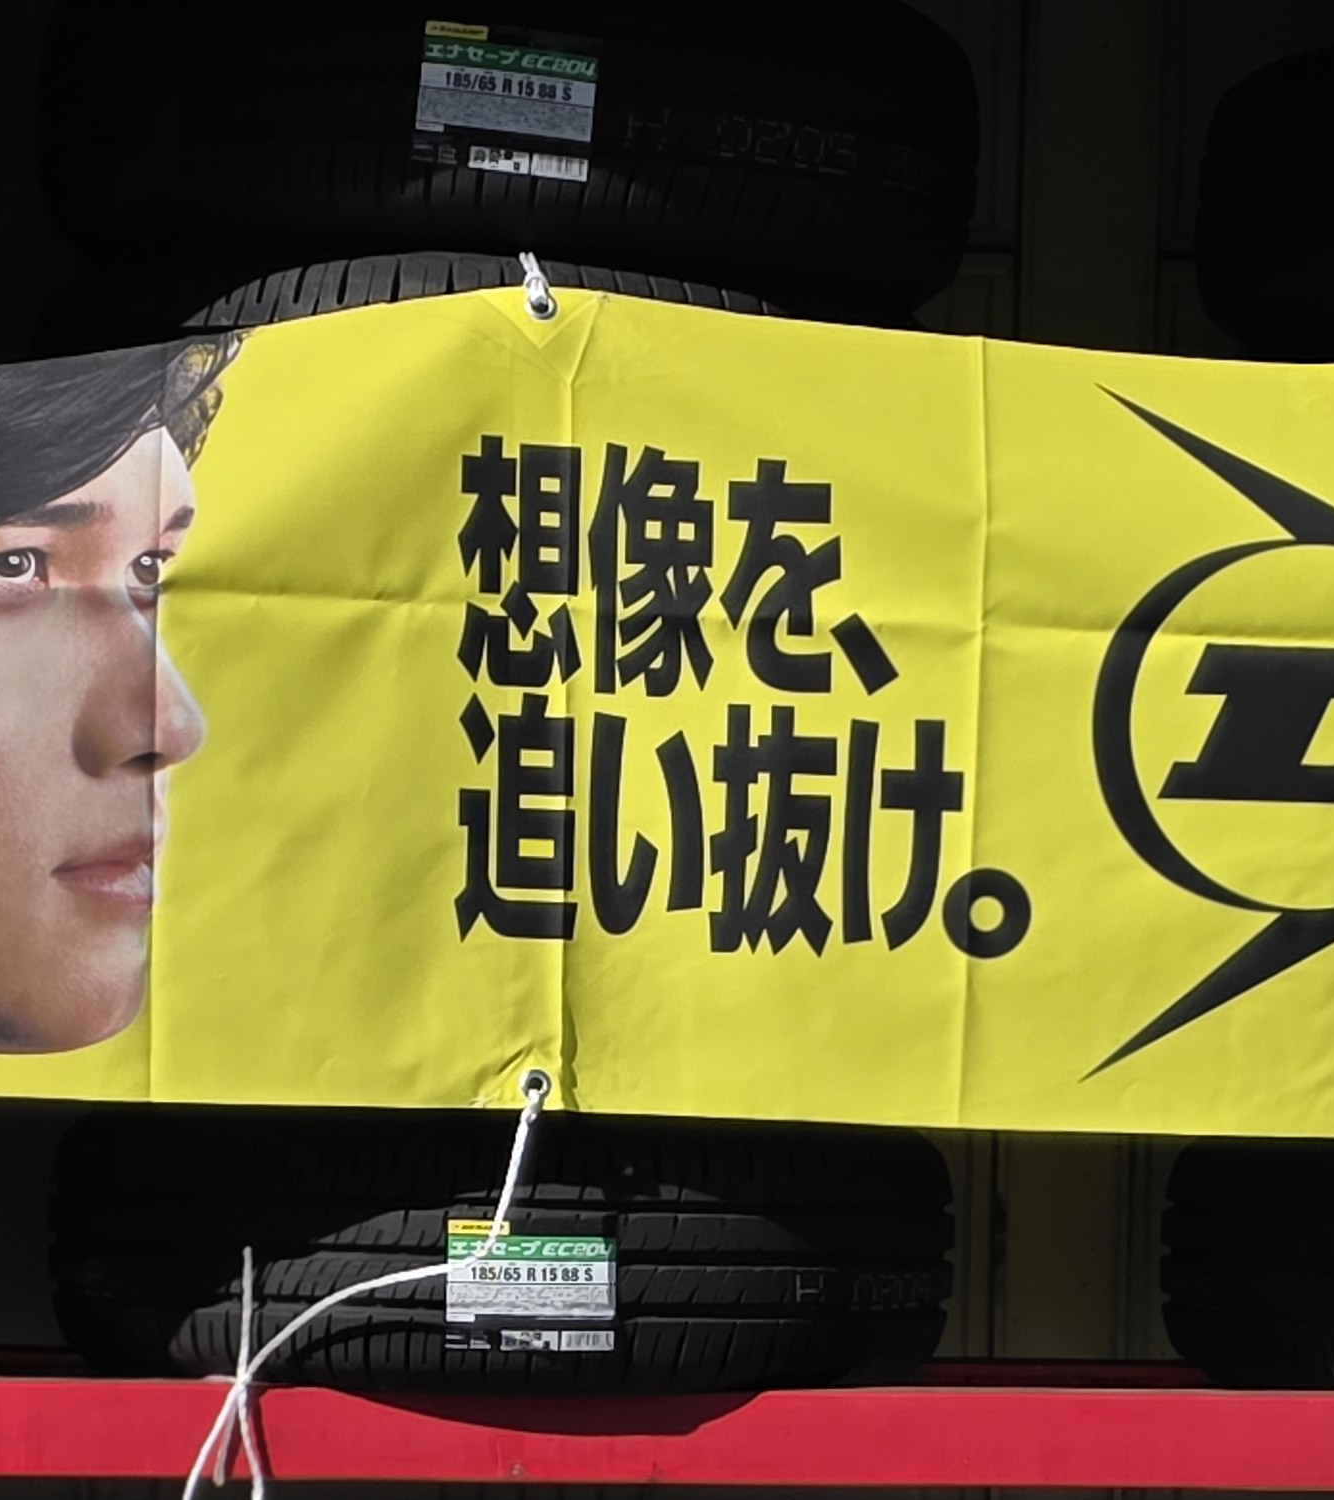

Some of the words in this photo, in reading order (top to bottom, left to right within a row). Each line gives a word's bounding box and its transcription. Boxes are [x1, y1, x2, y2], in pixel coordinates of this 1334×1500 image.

[562, 85, 572, 101] S
[456, 434, 900, 697] 想像を、
[454, 692, 1032, 960] 追い抜け。
[542, 1242, 612, 1257] EC204
[471, 1267, 521, 1281] 185/65
[527, 1267, 536, 1281] R
[541, 1267, 557, 1281] 15
[561, 1267, 580, 1281] 88
[584, 1267, 593, 1281] S
